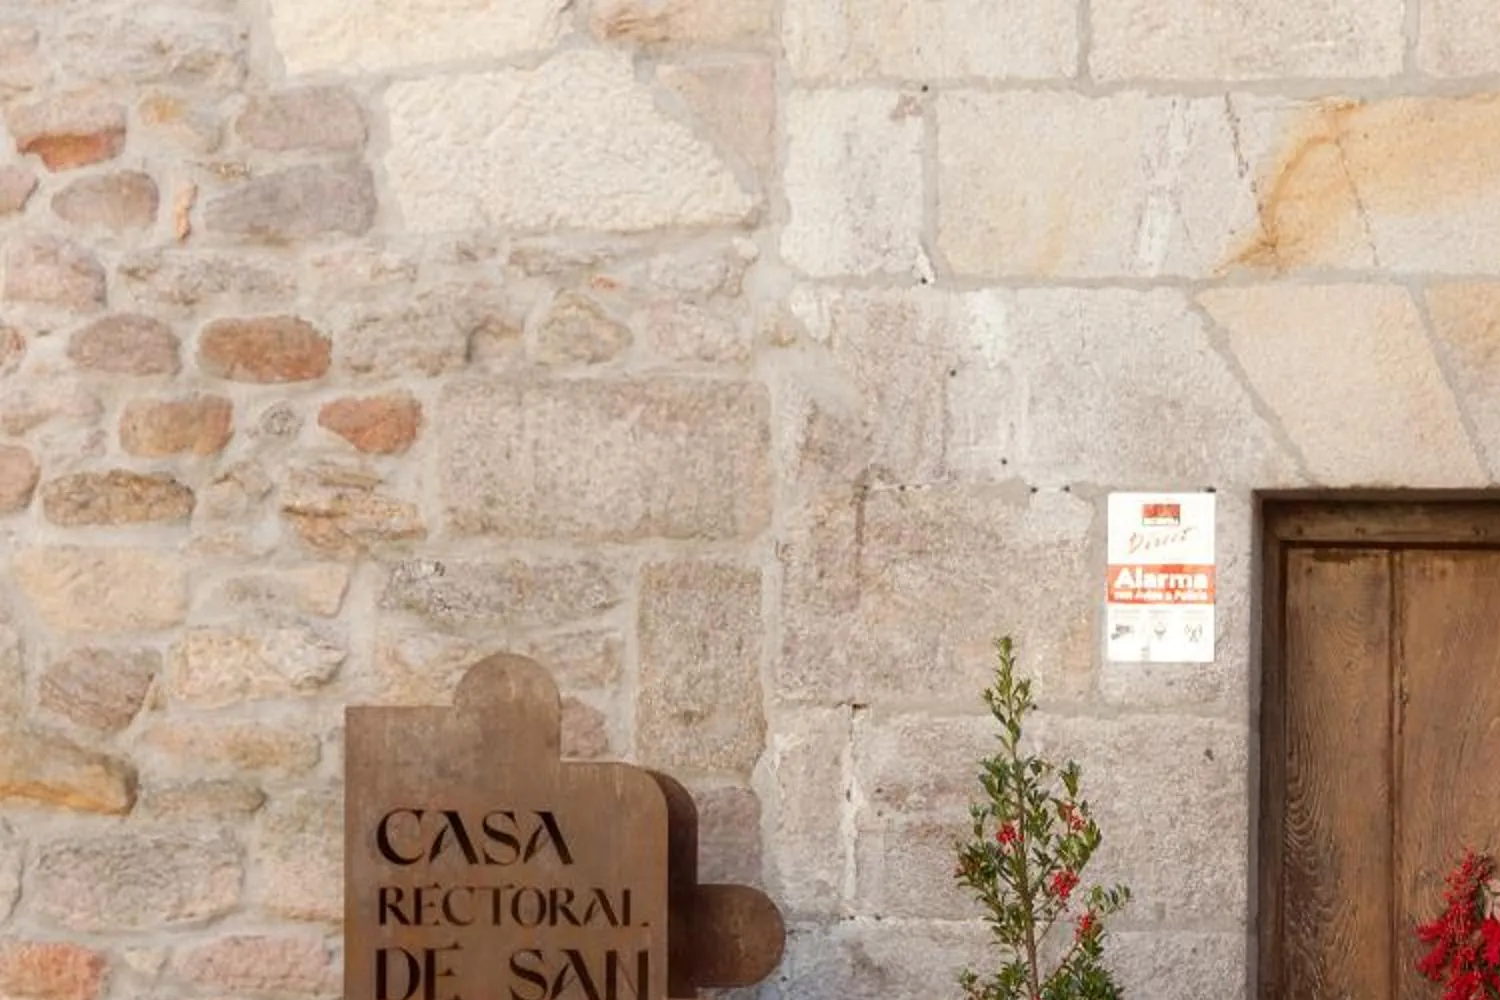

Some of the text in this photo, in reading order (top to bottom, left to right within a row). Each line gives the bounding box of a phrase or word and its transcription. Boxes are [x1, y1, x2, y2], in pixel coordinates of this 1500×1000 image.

[1114, 566, 1208, 589] Alarma
[376, 807, 574, 866] CASA
[377, 883, 650, 928] RECTORAL
